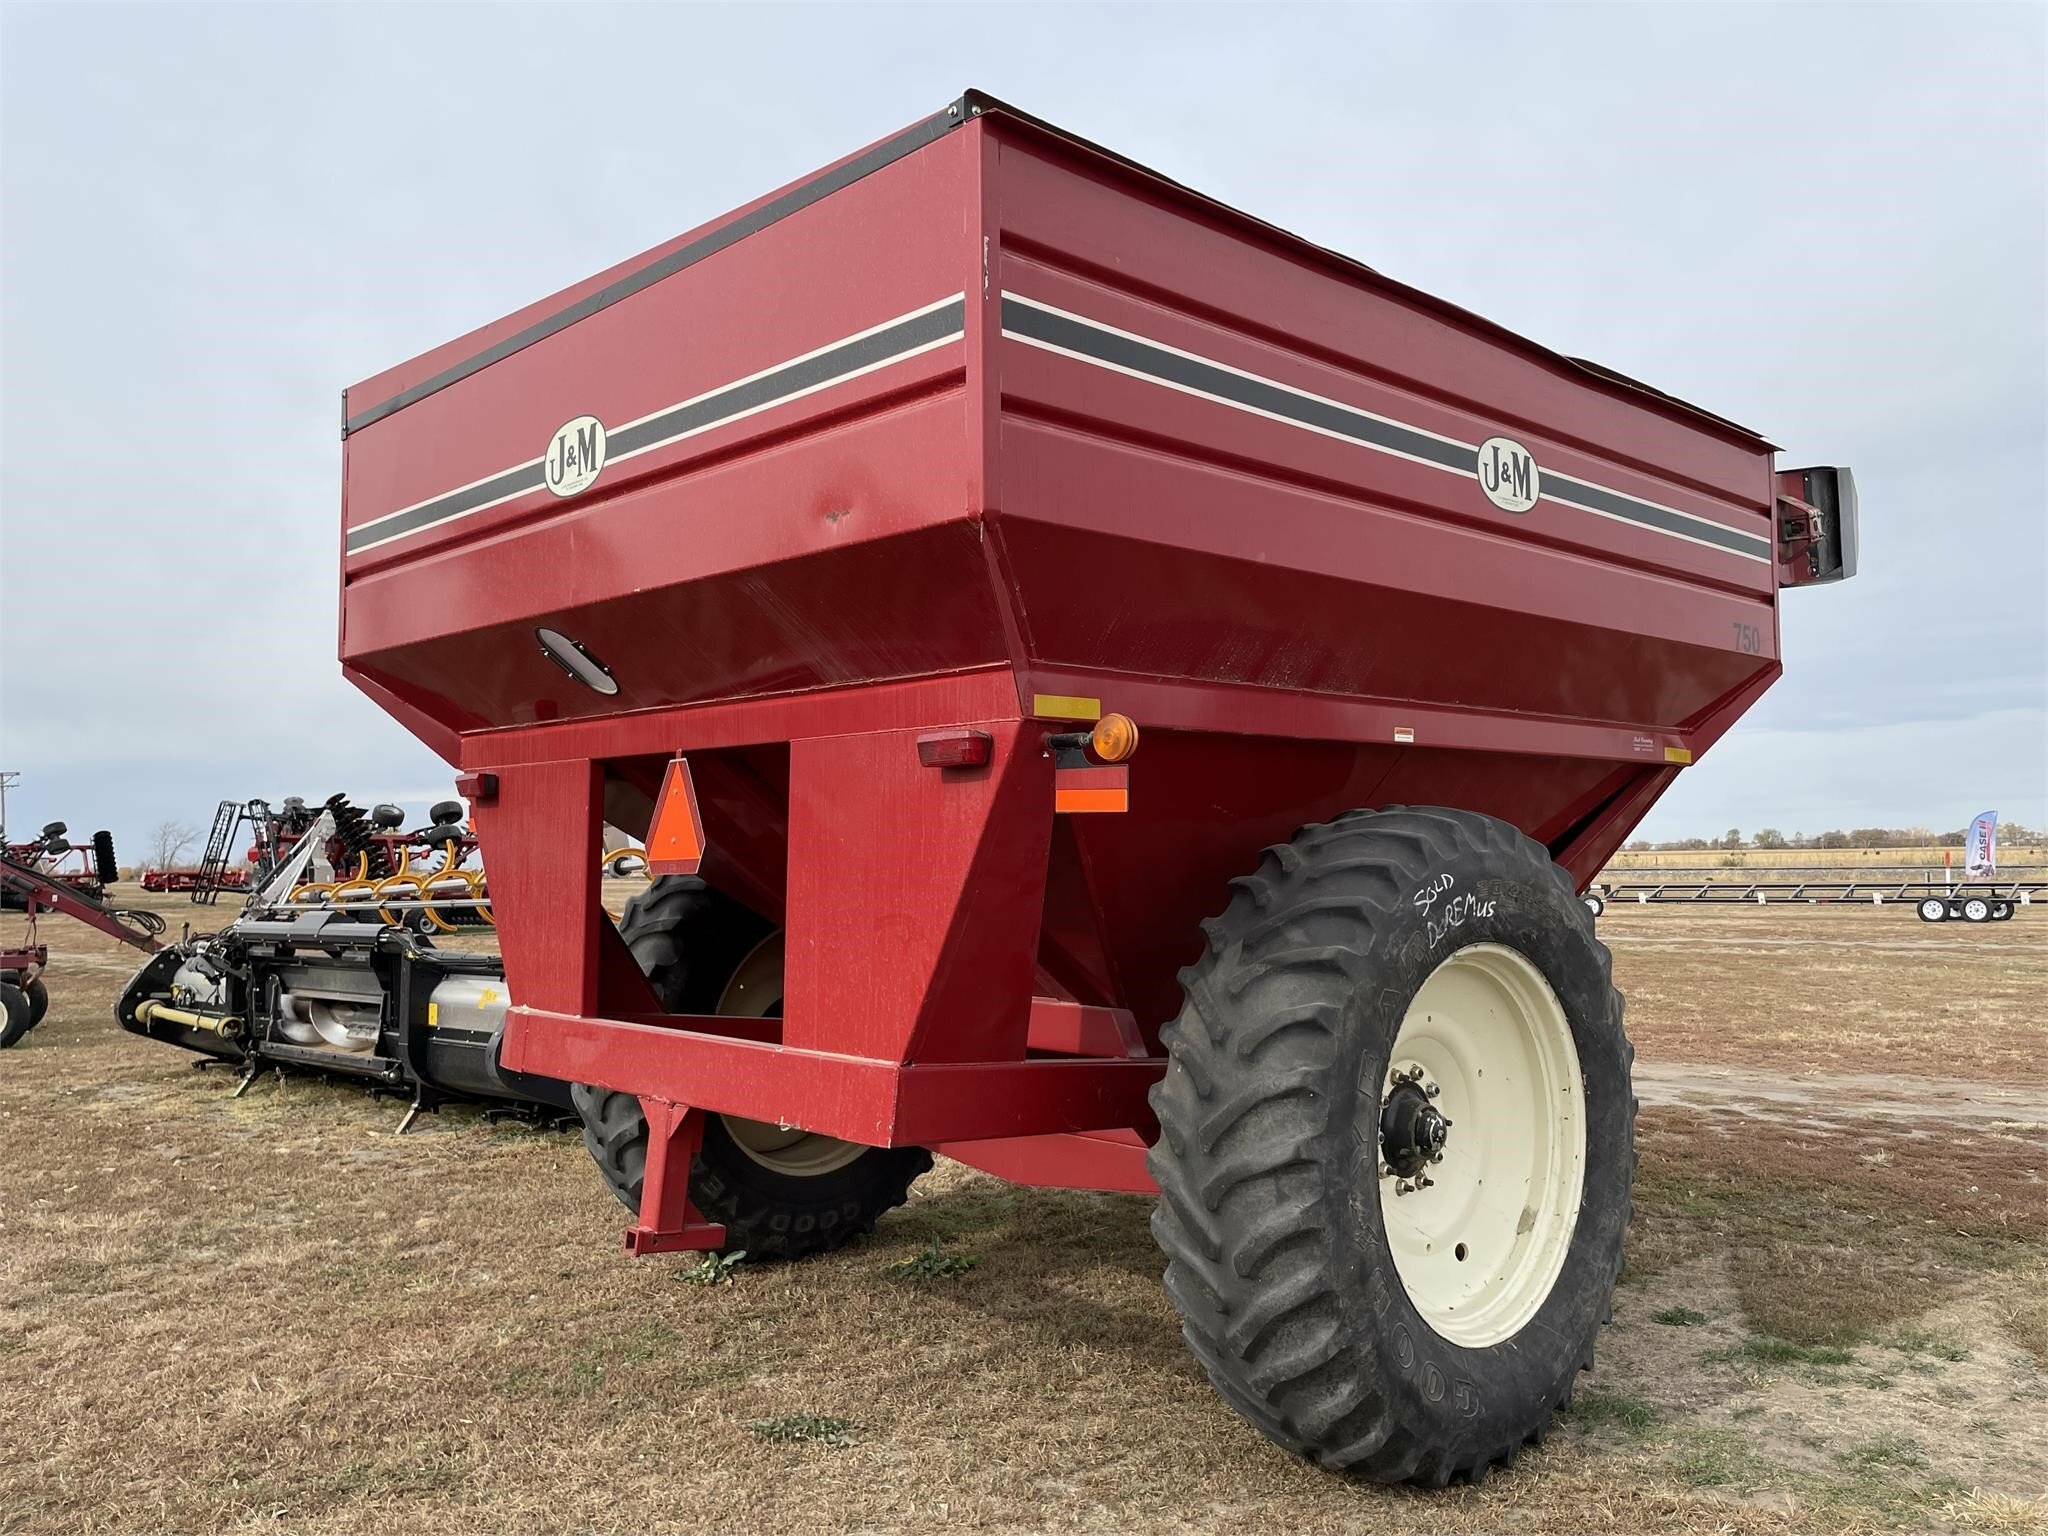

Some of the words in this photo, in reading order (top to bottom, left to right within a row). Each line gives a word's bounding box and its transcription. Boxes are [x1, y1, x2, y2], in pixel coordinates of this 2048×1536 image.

[550, 421, 598, 486] J&M
[1483, 445, 1533, 501] J&M
[1733, 622, 1761, 654] 750
[1979, 829, 1987, 861] CASE
[1413, 873, 1455, 917] SOLD
